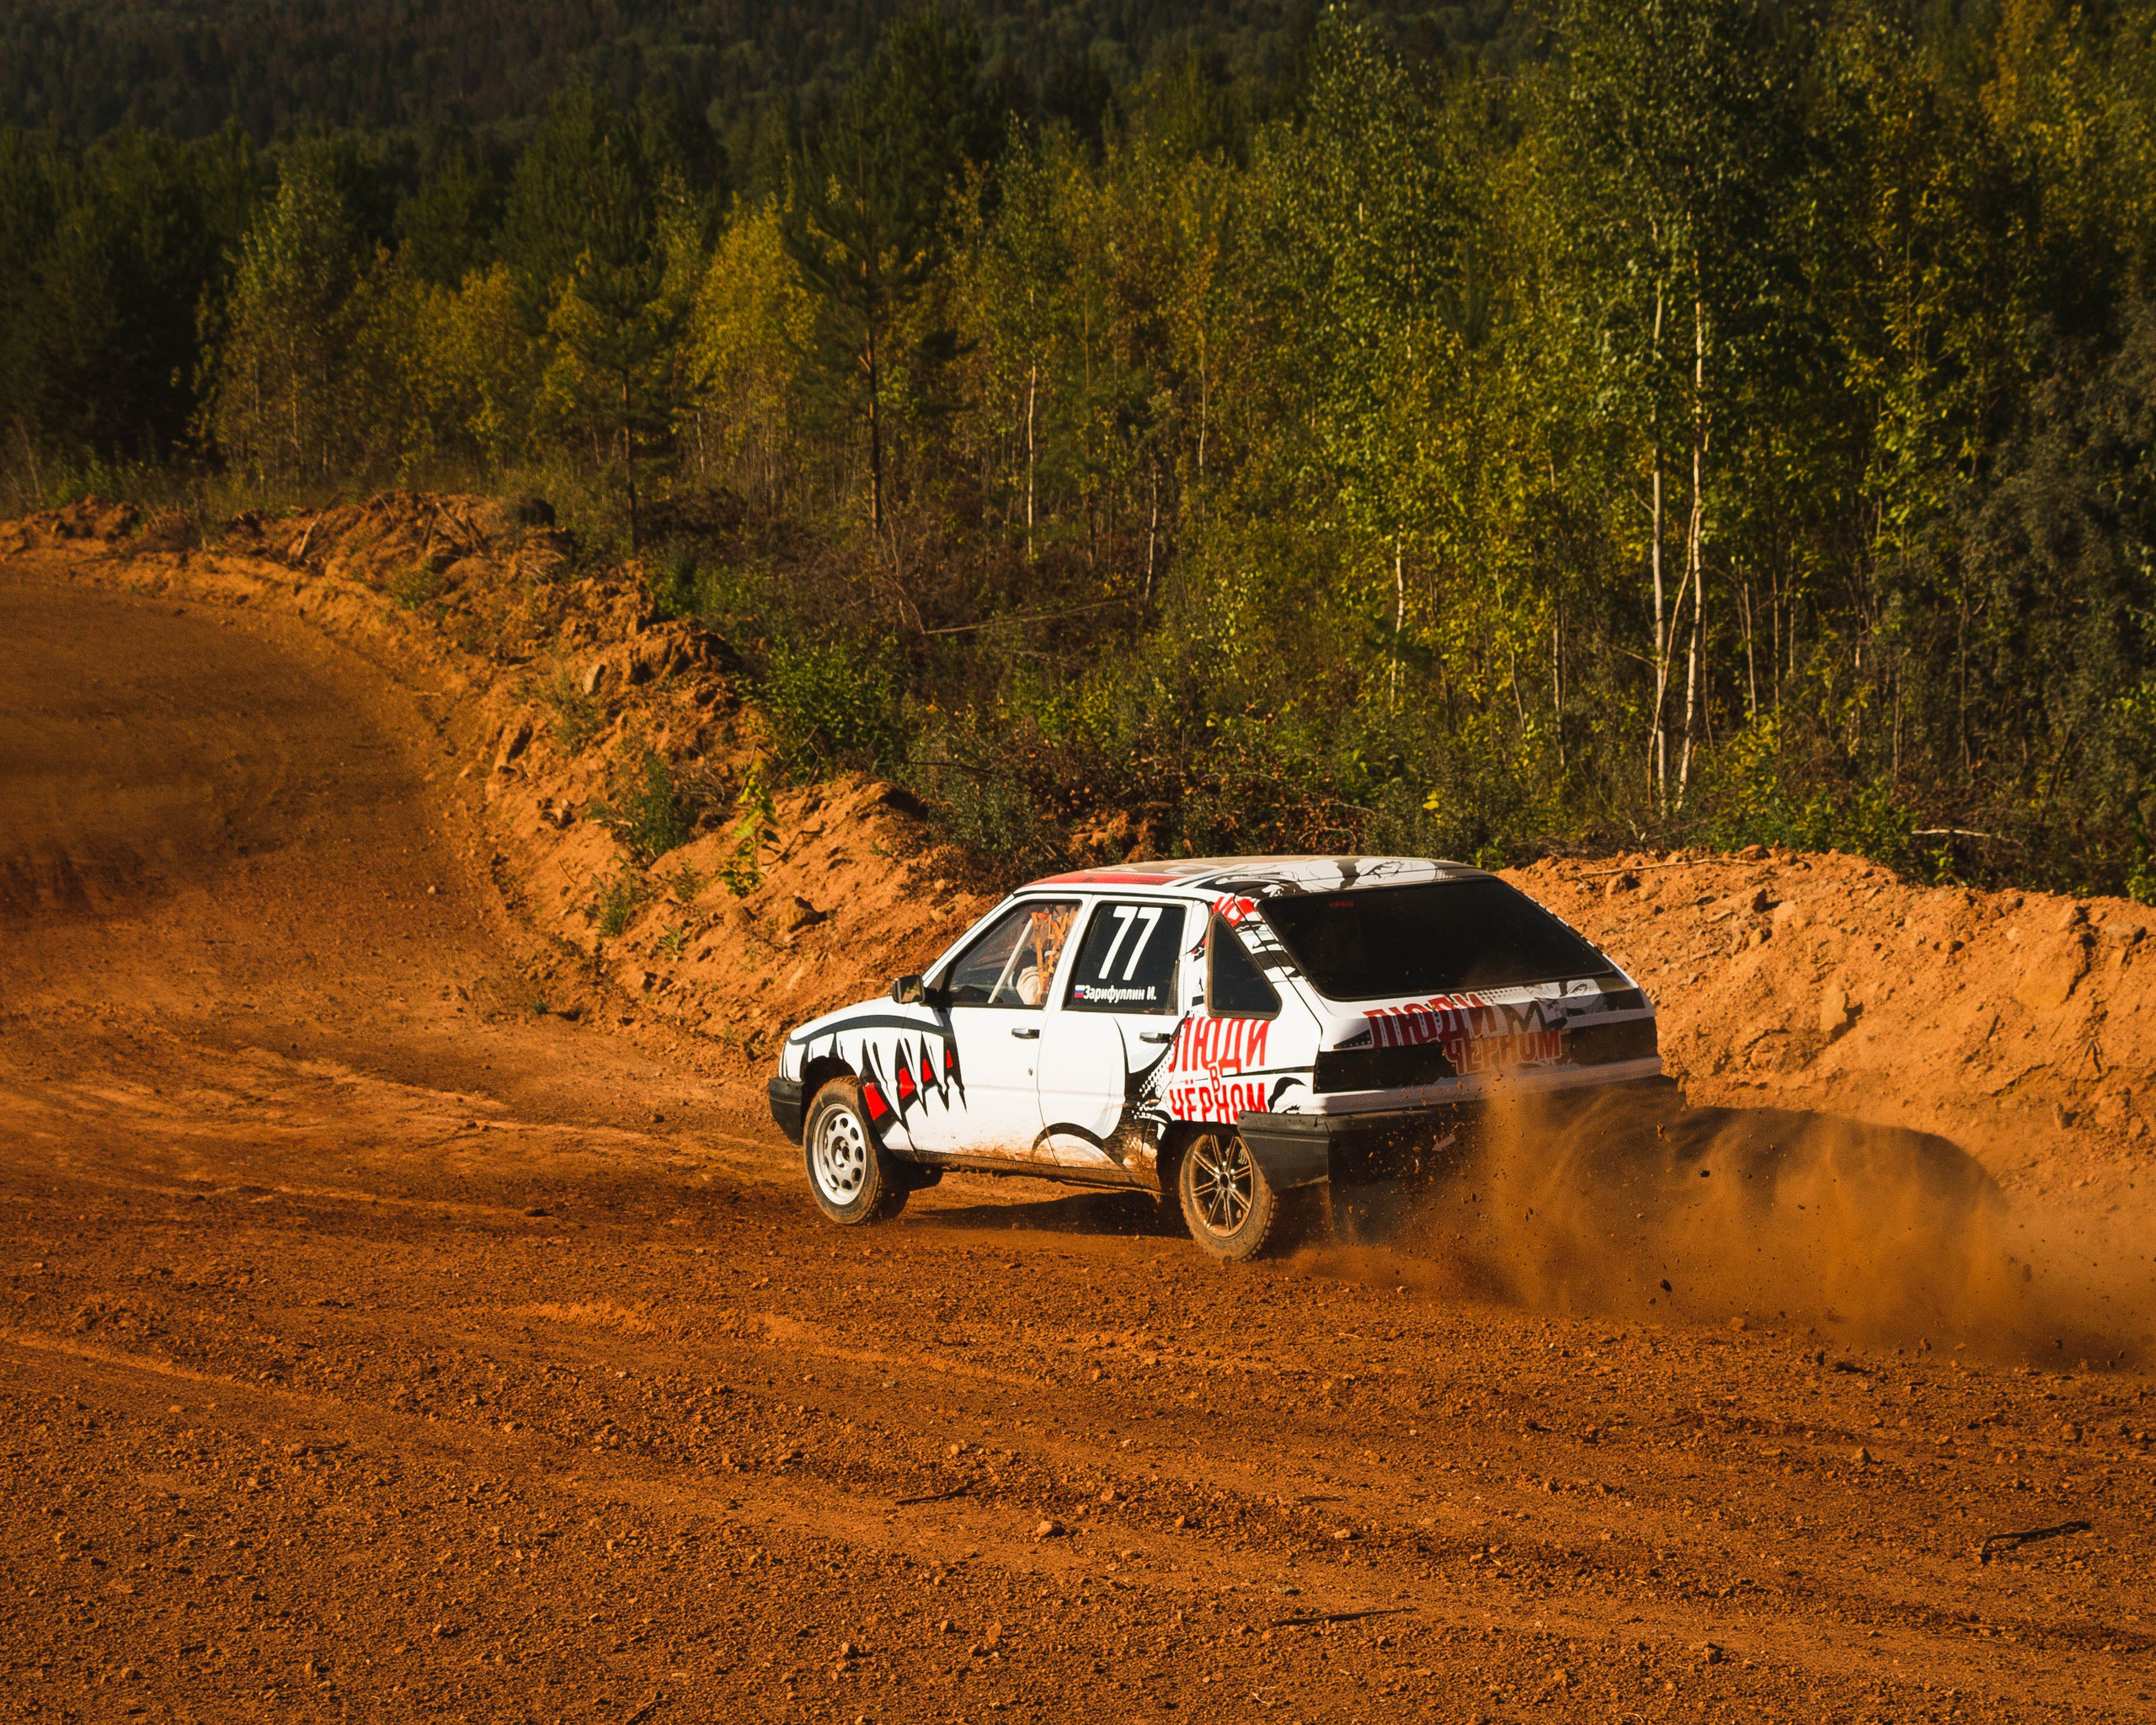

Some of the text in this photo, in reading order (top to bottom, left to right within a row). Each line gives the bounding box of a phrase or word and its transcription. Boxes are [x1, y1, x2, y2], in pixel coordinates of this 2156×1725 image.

[1098, 905, 1163, 981] 77
[1083, 985, 1157, 1004] Зарифуллин И.
[1364, 993, 1498, 1049] ЛЮДИ
[1168, 1016, 1271, 1076] ЛЮДИ
[1169, 1078, 1267, 1124] ЧЁРНОМ
